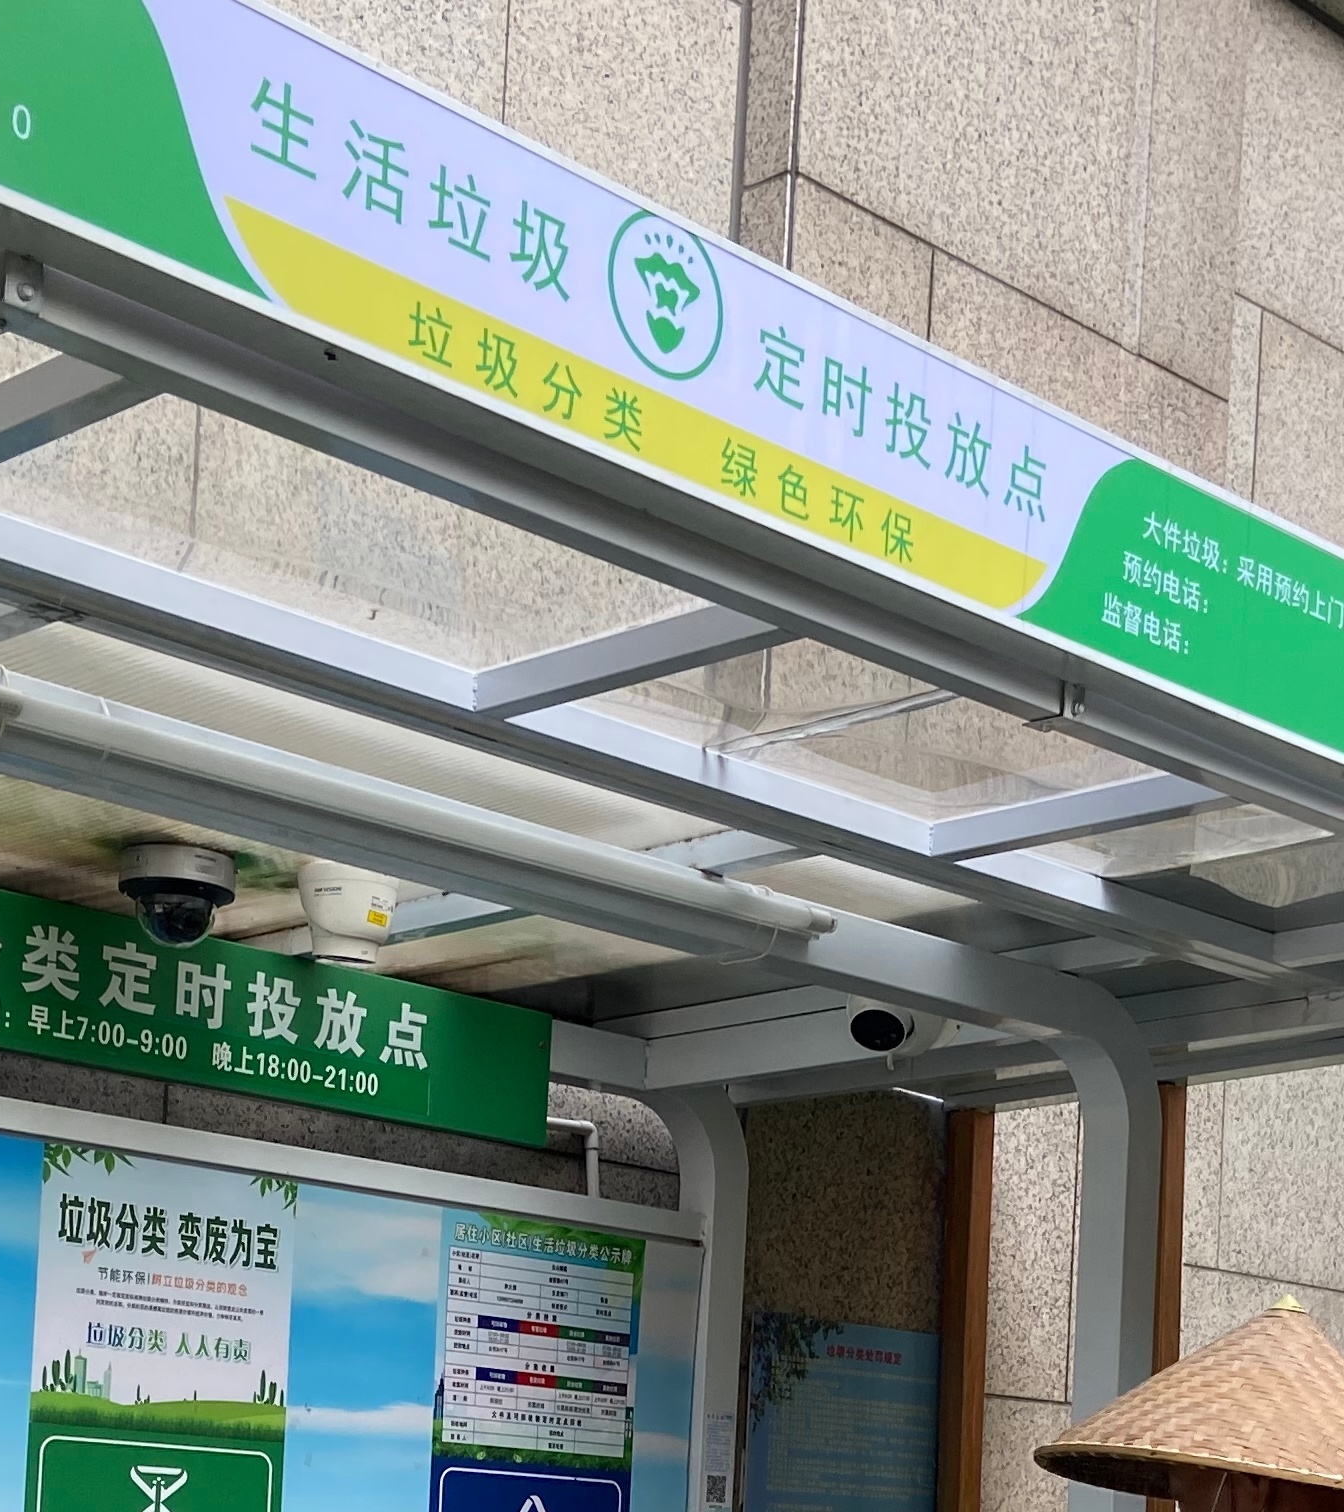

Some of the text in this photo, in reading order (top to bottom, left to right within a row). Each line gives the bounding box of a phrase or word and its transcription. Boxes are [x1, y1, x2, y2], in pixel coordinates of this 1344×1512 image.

[250, 77, 1048, 523] 生活垃圾 定时投放点
[408, 301, 915, 563] 垃圾分类 绿色环保
[58, 1193, 281, 1272] 垃圾分类 变废为宝
[85, 1320, 252, 1365] 垃圾分类 人人有责
